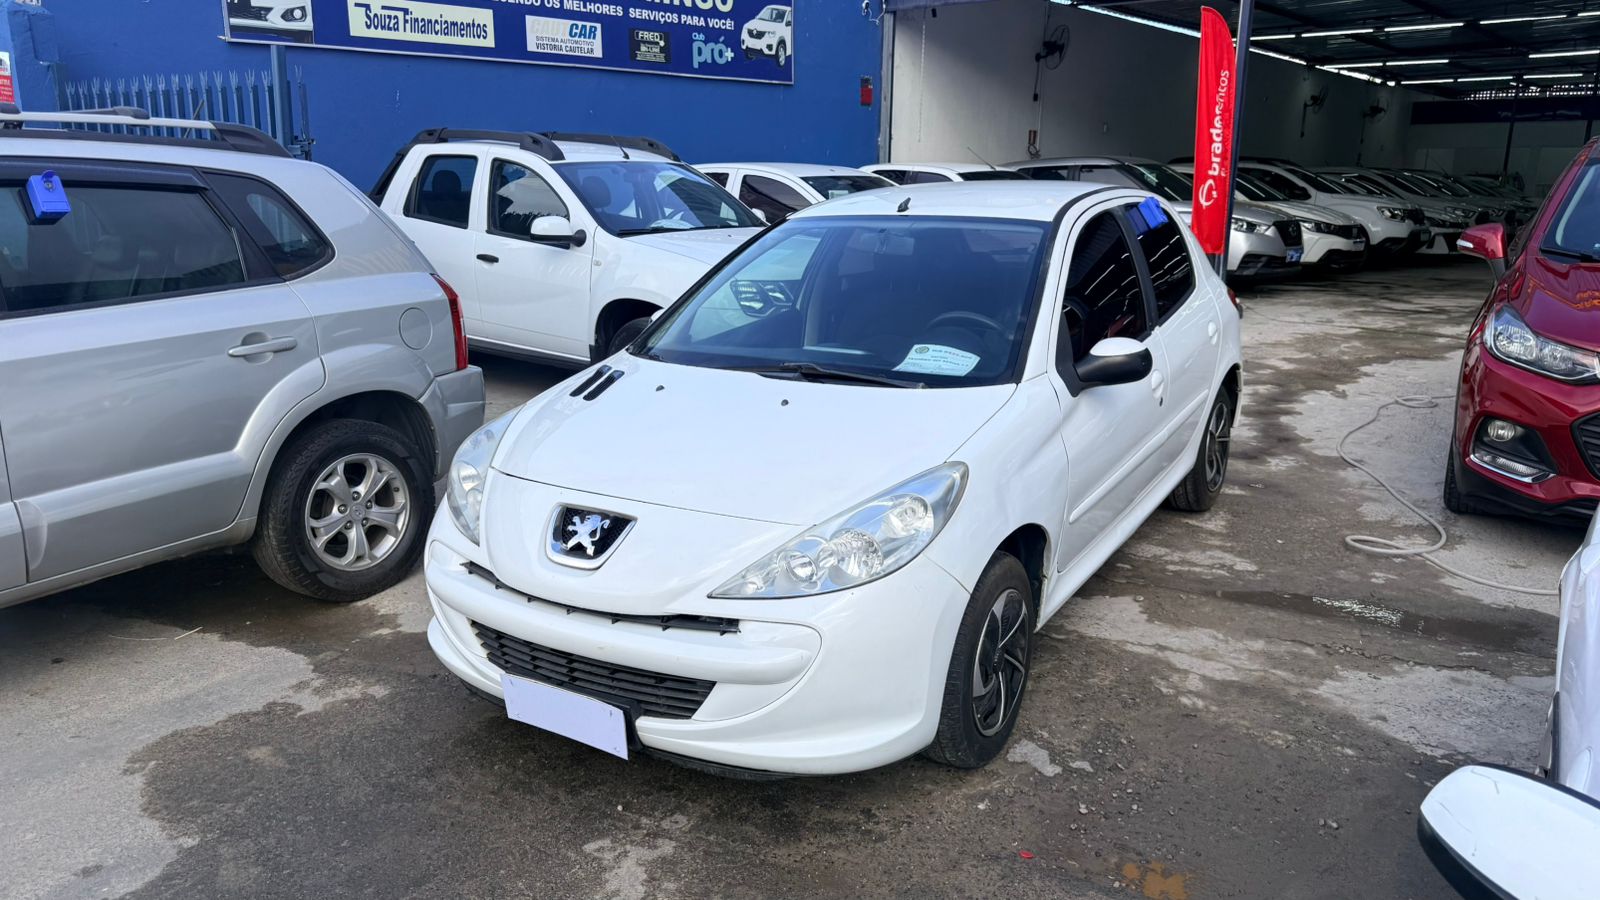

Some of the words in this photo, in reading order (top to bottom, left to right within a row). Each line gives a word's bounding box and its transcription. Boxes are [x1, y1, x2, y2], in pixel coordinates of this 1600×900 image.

[545, 0, 560, 8] OS
[563, 0, 624, 16] MELHORES
[629, 7, 679, 24] SERVIÇOS
[681, 14, 706, 27] PARA
[707, 17, 734, 30] VOCÊ!
[363, 4, 399, 32] Souza
[403, 7, 488, 40] Financiamentos
[536, 35, 560, 43] SISTEMA
[560, 38, 595, 47] AUTOMOTIVO
[639, 31, 660, 42] FRED
[535, 42, 564, 52] VISTORIA
[564, 45, 595, 55] CAUTELAR
